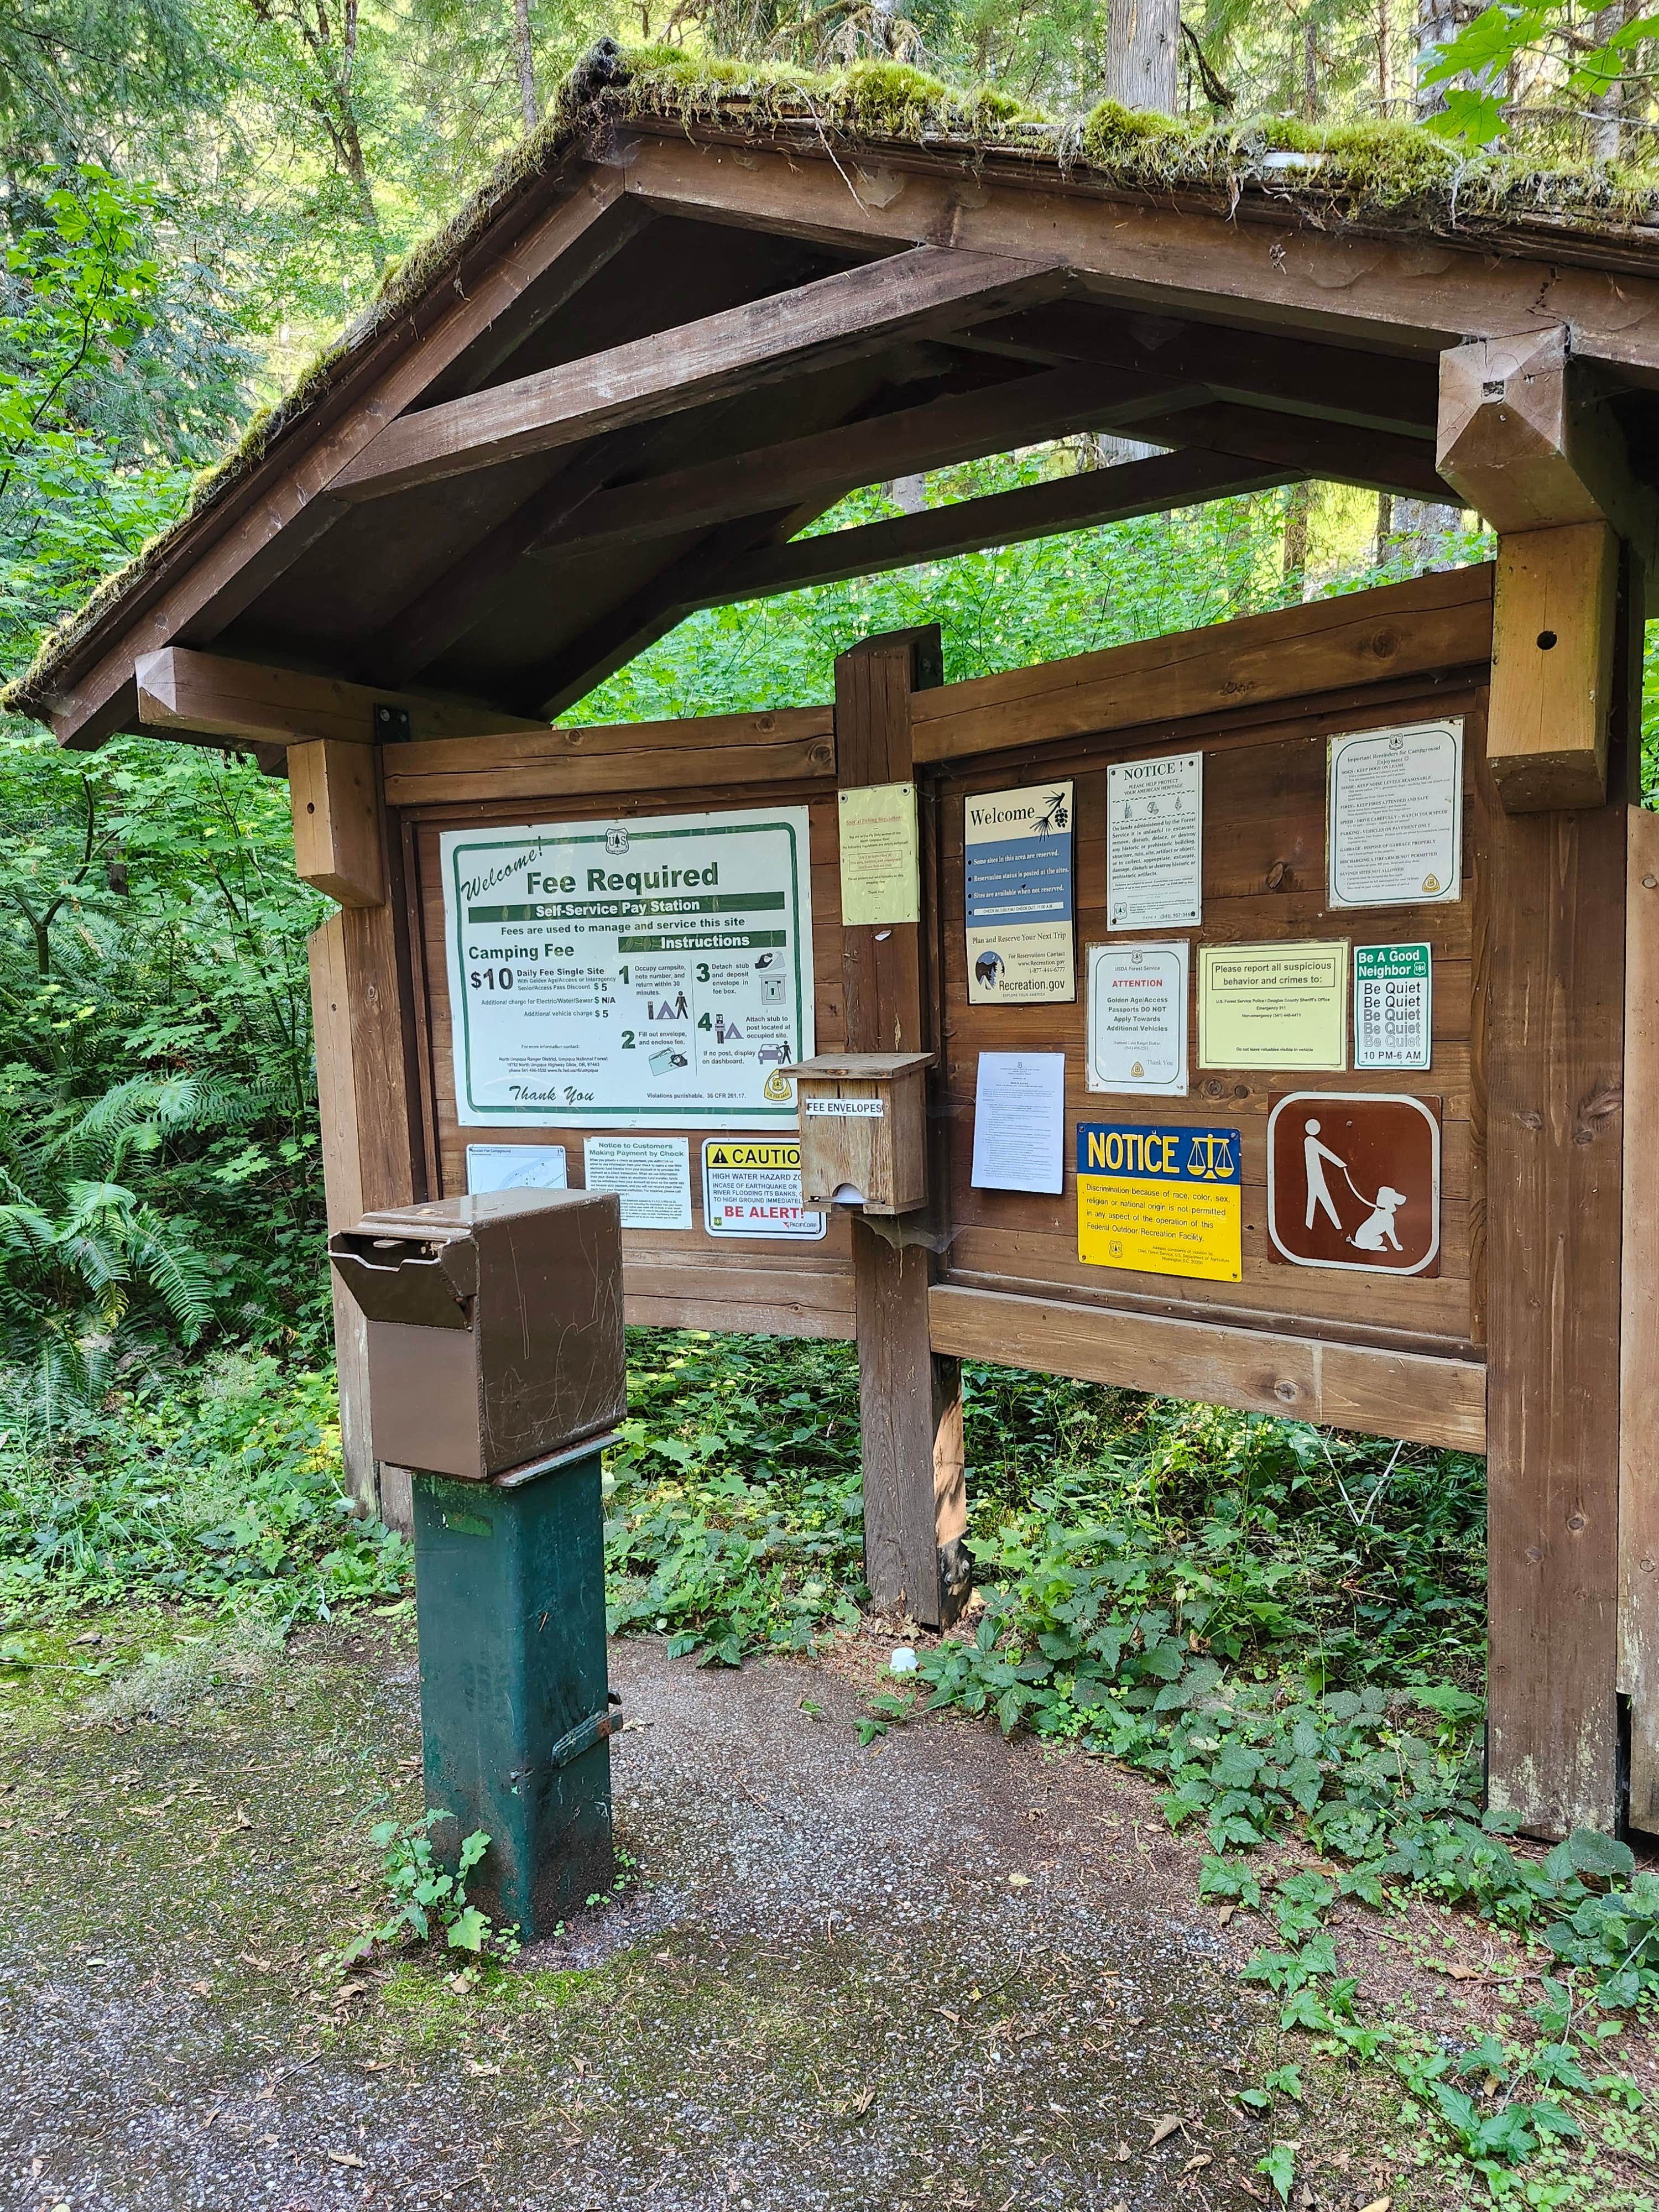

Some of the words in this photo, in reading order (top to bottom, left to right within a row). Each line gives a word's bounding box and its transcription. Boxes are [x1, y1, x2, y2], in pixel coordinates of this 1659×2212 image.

[1407, 745, 1441, 755] Campground
[1376, 757, 1403, 766] Enjoyment
[1124, 762, 1175, 780] NOTICE
[971, 807, 1035, 826] Welcome
[1036, 849, 1059, 858] reserved.
[461, 836, 543, 902] Welcome!
[527, 872, 576, 894] Fee
[587, 862, 718, 893] Required
[536, 903, 617, 917] Self-Service
[622, 902, 646, 915] Pay
[650, 899, 700, 914] Station
[501, 927, 524, 935] Fees
[546, 924, 570, 933] used
[574, 924, 585, 932] to
[588, 924, 630, 933] manage
[634, 921, 653, 930] and
[657, 920, 696, 929] service
[700, 918, 720, 927] this
[724, 917, 745, 926] site
[661, 935, 749, 949] Instructions
[1053, 931, 1066, 940] Trip
[469, 945, 538, 961] Camping
[544, 943, 574, 957] Fee
[1359, 952, 1373, 963] Be
[1377, 951, 1385, 962] A
[1389, 950, 1419, 963] Good
[517, 969, 536, 978] Daily
[557, 968, 583, 977] Single
[696, 963, 710, 982] 3
[1244, 964, 1269, 973] report
[1271, 963, 1281, 971] all
[1284, 962, 1331, 972] suspicious
[1359, 964, 1412, 979] Neighbor
[471, 968, 513, 990] $10
[619, 966, 629, 984] 1
[999, 979, 1065, 992] Recreation.gov
[1364, 983, 1380, 994] Be
[1386, 982, 1420, 994] Quiet
[1364, 997, 1380, 1008] Be
[1385, 995, 1420, 1008] Quiet
[1364, 1009, 1380, 1021] Be
[1385, 1008, 1420, 1021] Quiet
[698, 1013, 712, 1031] 4
[1364, 1022, 1380, 1034] Be
[1385, 1021, 1420, 1035] Quiet
[622, 1031, 635, 1048] 2
[1364, 1035, 1381, 1047] Be
[1385, 1035, 1420, 1048] Quiet
[1406, 1051, 1420, 1059] AM
[509, 1086, 556, 1100] Thank
[564, 1086, 594, 1105] You
[806, 1103, 825, 1111] FEE
[828, 1103, 881, 1114] ENVELOPES
[732, 1149, 800, 1164] CAUTIO
[1088, 1132, 1179, 1173] NOTICE
[1086, 1183, 1129, 1194] Discrimination
[1131, 1187, 1159, 1196] because
[724, 1206, 744, 1217] BE
[749, 1207, 805, 1218] ALERT!
